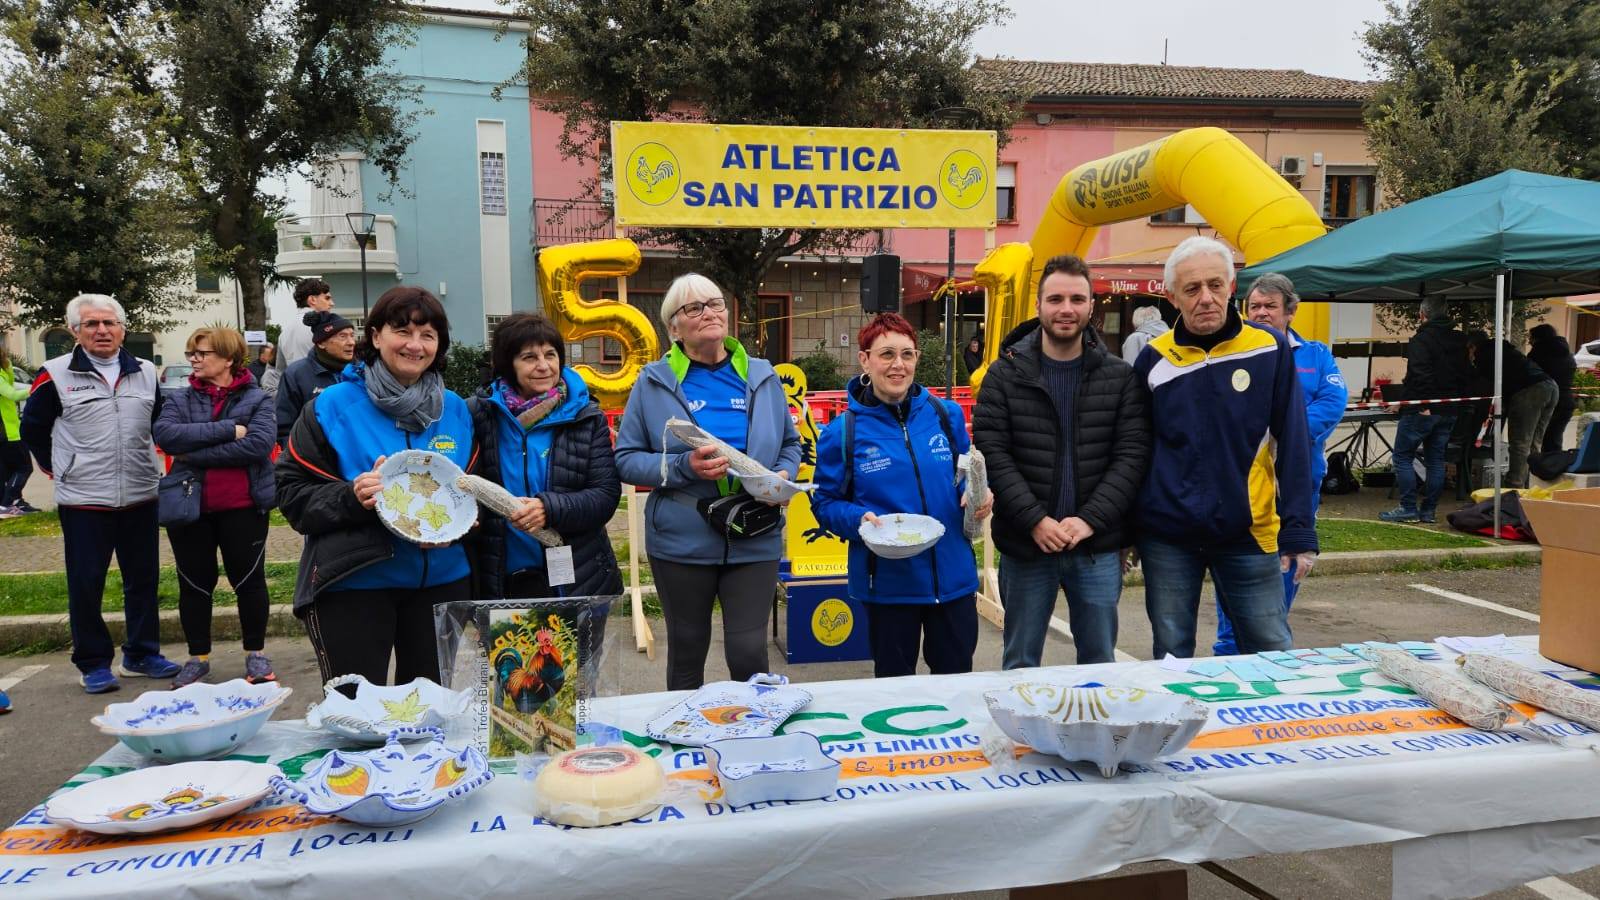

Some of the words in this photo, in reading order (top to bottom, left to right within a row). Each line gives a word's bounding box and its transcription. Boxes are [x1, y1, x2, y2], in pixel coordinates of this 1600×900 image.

[721, 143, 901, 172] ATLETICA
[1101, 149, 1150, 188] UISP
[682, 181, 759, 208] SAN
[773, 183, 938, 210] PATRIZIO
[1111, 280, 1139, 294] Wine
[477, 700, 488, 731] Trofeo
[1217, 702, 1324, 726] CREDITO
[1252, 719, 1387, 741] ravennate
[1164, 752, 1297, 772] BANCA
[981, 767, 1083, 790] LOCALI
[66, 838, 265, 878] COMUNITÀ
[289, 828, 414, 857] LOCALI
[470, 815, 507, 833] LA
